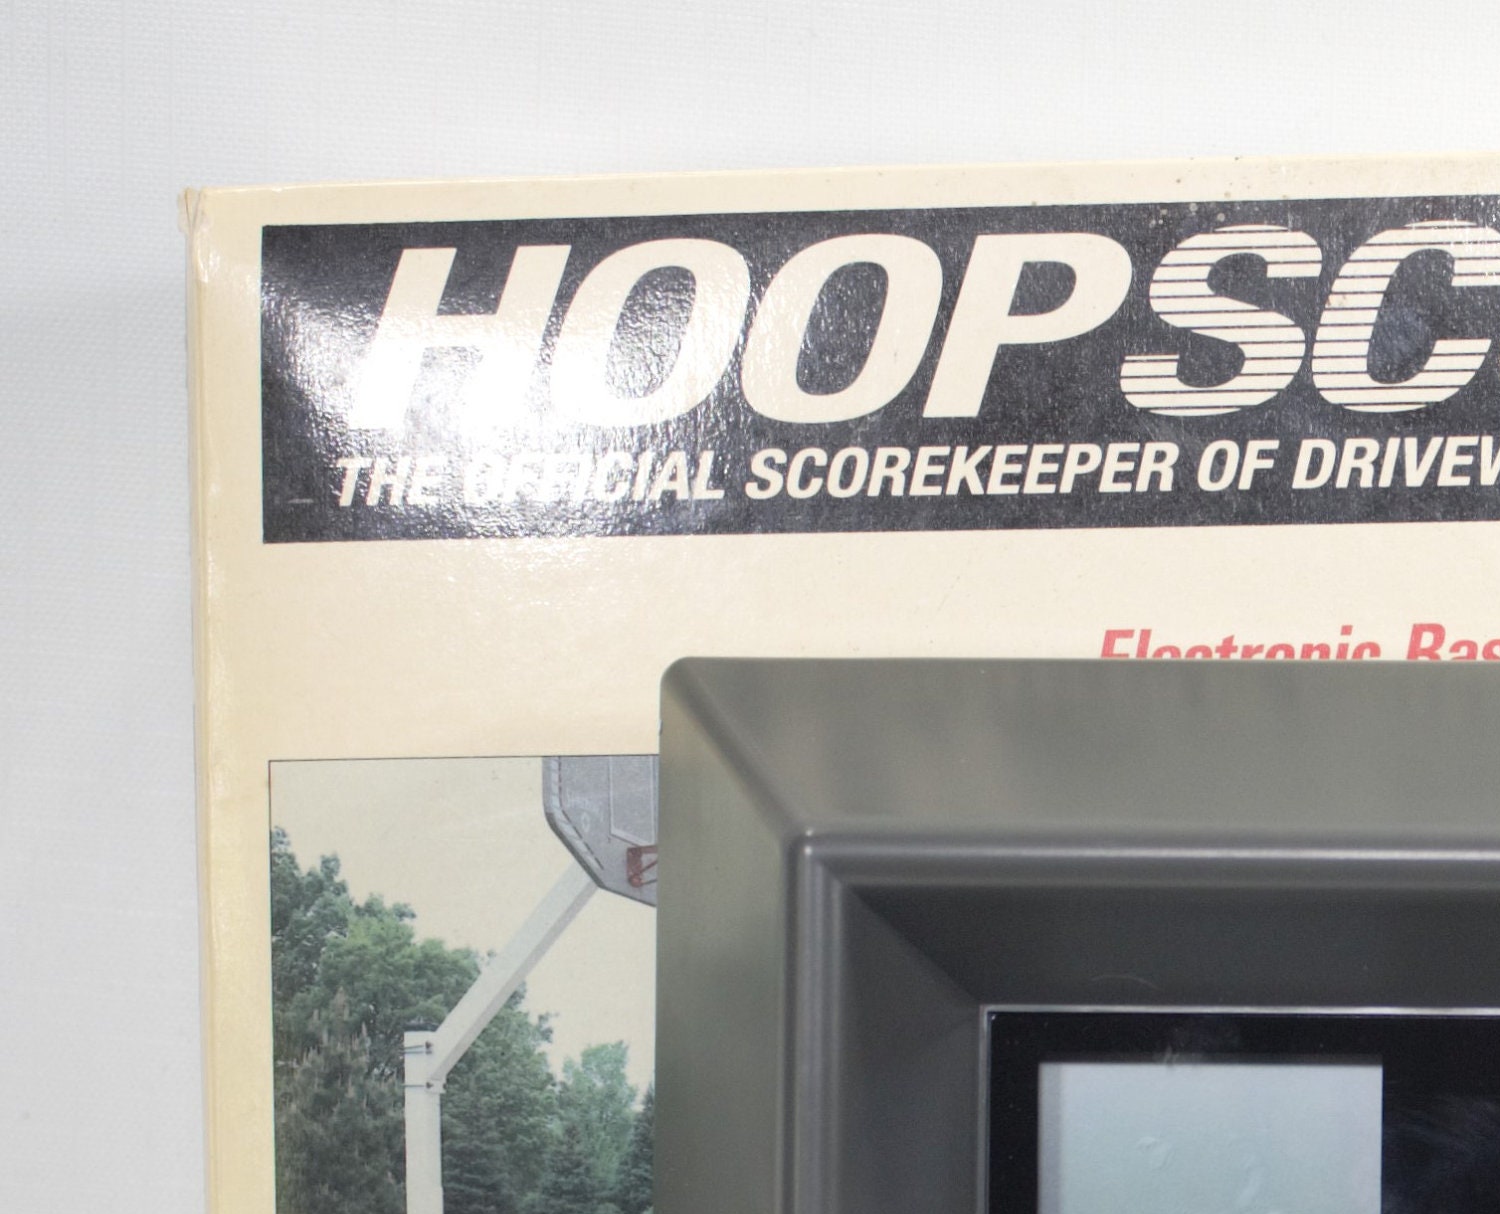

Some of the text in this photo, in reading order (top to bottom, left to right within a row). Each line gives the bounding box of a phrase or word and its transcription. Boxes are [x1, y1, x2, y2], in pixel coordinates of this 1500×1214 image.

[335, 455, 445, 507] THE
[744, 442, 1180, 500] SCOREKEEPER
[1197, 437, 1277, 492] OF
